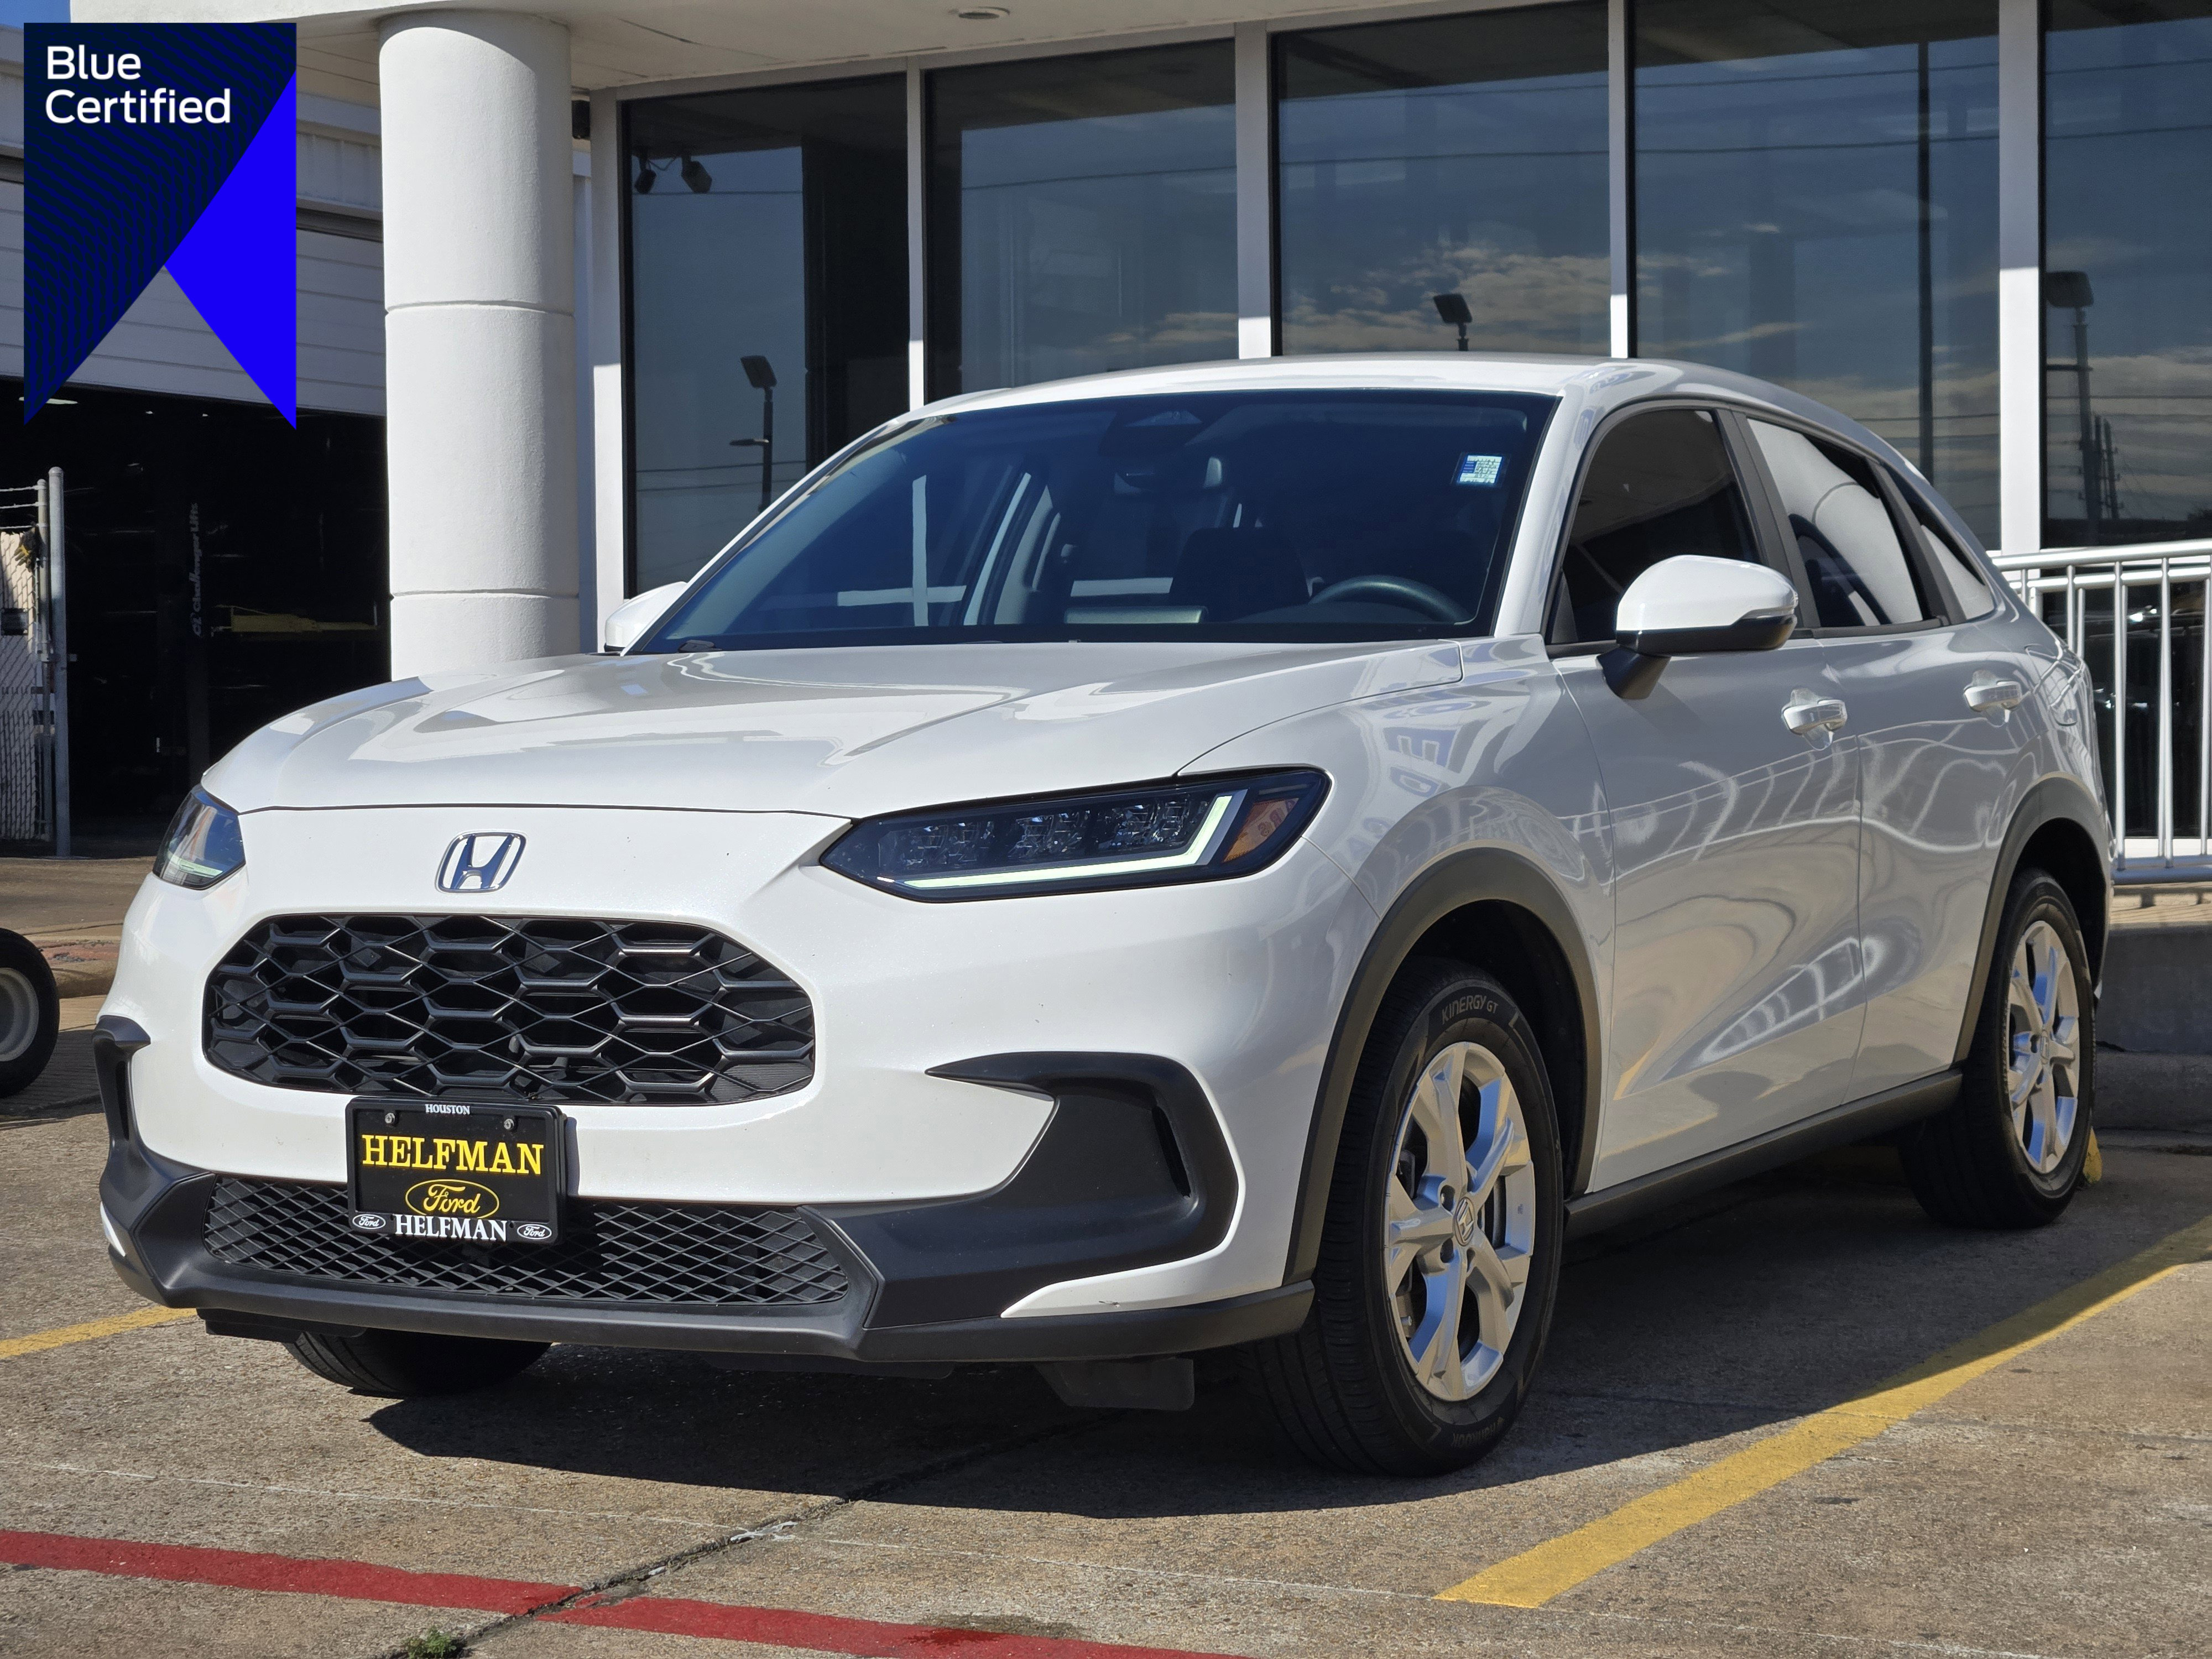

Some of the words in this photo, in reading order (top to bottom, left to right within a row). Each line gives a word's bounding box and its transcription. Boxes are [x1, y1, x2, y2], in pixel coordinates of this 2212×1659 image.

[1442, 995, 1486, 1025] KINERGY
[1487, 1000, 1498, 1014] GT
[425, 1104, 471, 1115] HOUSTON
[361, 1134, 544, 1175] HELFMAN
[423, 1183, 481, 1214] Ford
[358, 1215, 381, 1227] Ford
[394, 1214, 507, 1241] HELFMAN
[523, 1226, 546, 1238] Ford
